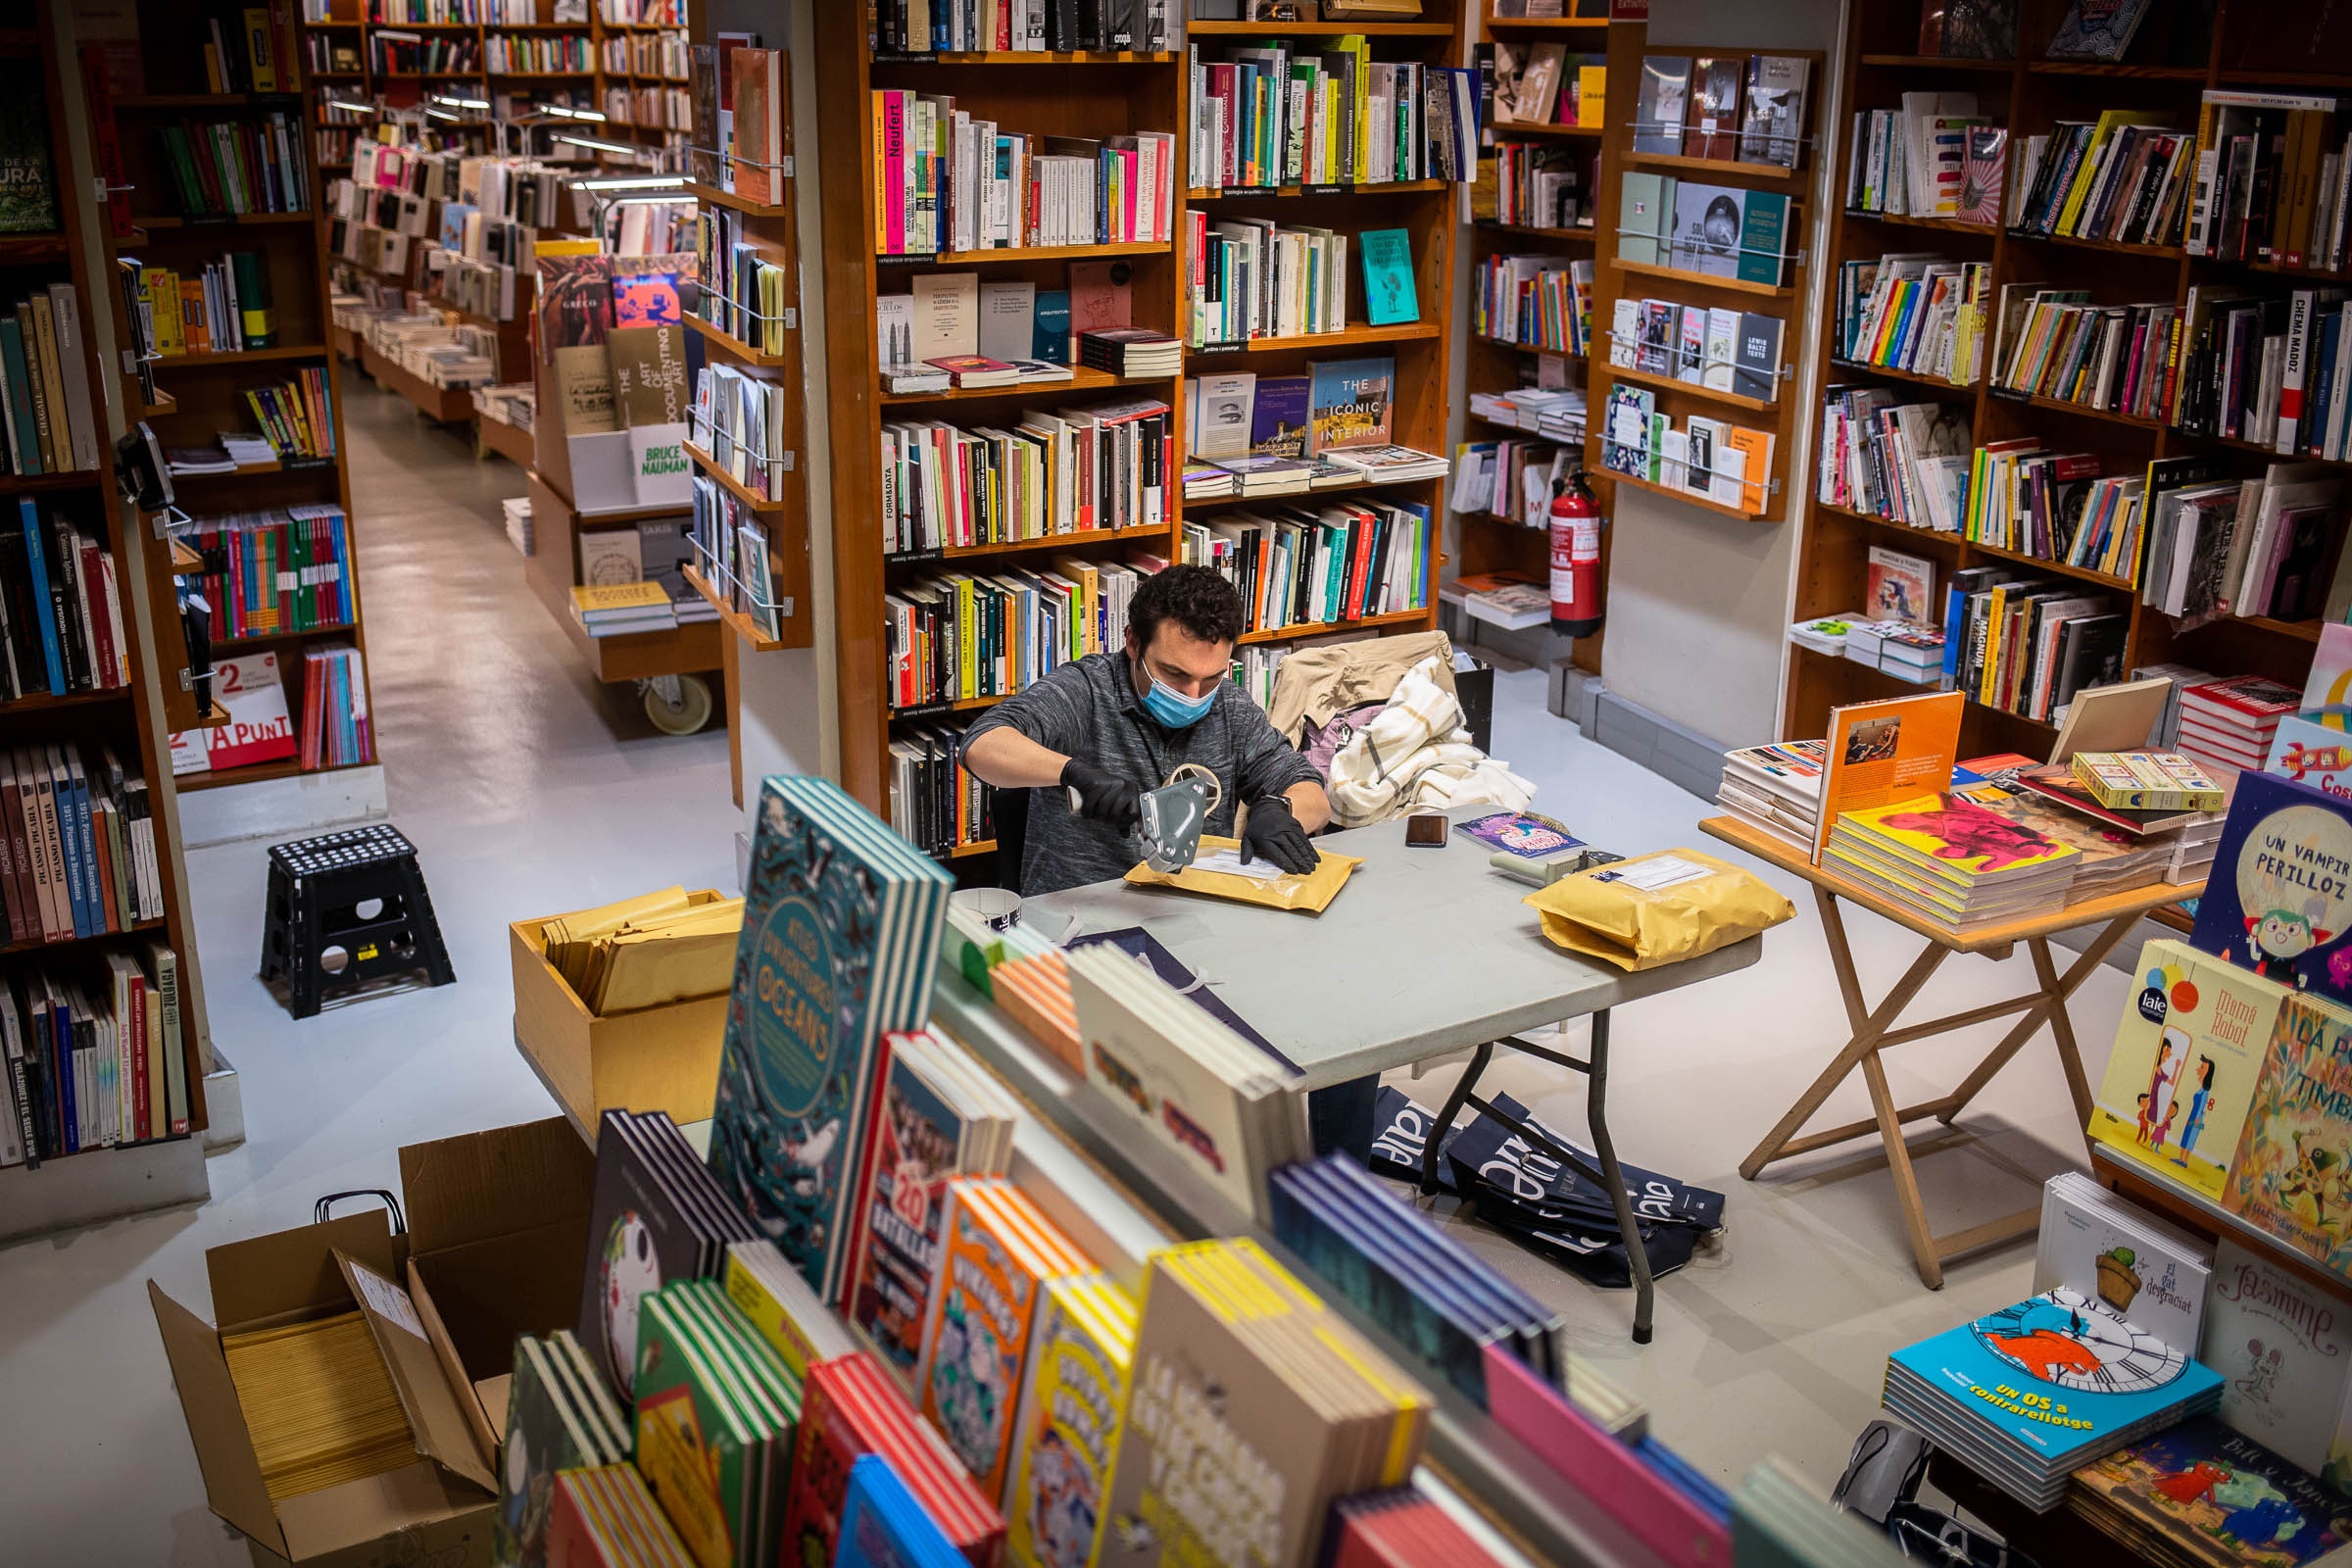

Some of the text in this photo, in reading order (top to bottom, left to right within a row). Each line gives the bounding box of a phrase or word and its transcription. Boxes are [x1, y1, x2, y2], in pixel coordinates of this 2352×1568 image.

[888, 104, 901, 158] Neufert
[5, 158, 39, 167] DE LA
[2212, 174, 2225, 218] Lewis Baltz
[2170, 318, 2181, 345] ROBERT
[2287, 299, 2305, 373] CHEMA MADOZ
[2168, 345, 2180, 368] FRANK
[617, 368, 631, 394] THE
[639, 362, 652, 388] ART
[651, 369, 662, 388] OF
[657, 328, 678, 424] DOCUMENTING
[670, 361, 684, 386] ART
[1342, 378, 1369, 392] THE
[35, 392, 48, 436] CHAGALL
[1329, 401, 1380, 416] ICONIC
[1321, 423, 1387, 441] INTERIOR
[642, 459, 688, 476] NAUMAN
[646, 444, 680, 462] BRUCE
[59, 533, 74, 584] Cristina Iglesias
[2213, 521, 2234, 594] GENESIS
[57, 604, 67, 634] HOKUSAI
[1976, 619, 1987, 668] MAGNUM
[220, 663, 243, 694] 2
[213, 726, 231, 751] A
[0, 839, 12, 875] PICASSO
[16, 837, 27, 873] PICASSO
[67, 826, 76, 855] Picasso
[2265, 834, 2351, 877] UN VAMPIR
[81, 823, 91, 853] Picasso
[88, 864, 98, 903] Barcelona
[2256, 853, 2347, 901] PERILLOZ
[71, 862, 82, 901] Barcelona
[758, 964, 829, 1063] OCEANS
[2141, 993, 2167, 1014] laie
[2215, 988, 2258, 1025] Mamá
[2210, 1011, 2250, 1049] Robot
[2166, 1262, 2176, 1276] El
[2217, 1261, 2339, 1357] Jasmine
[1969, 1385, 2094, 1431] contrarellotge
[1995, 1383, 2068, 1414] UN OS a
